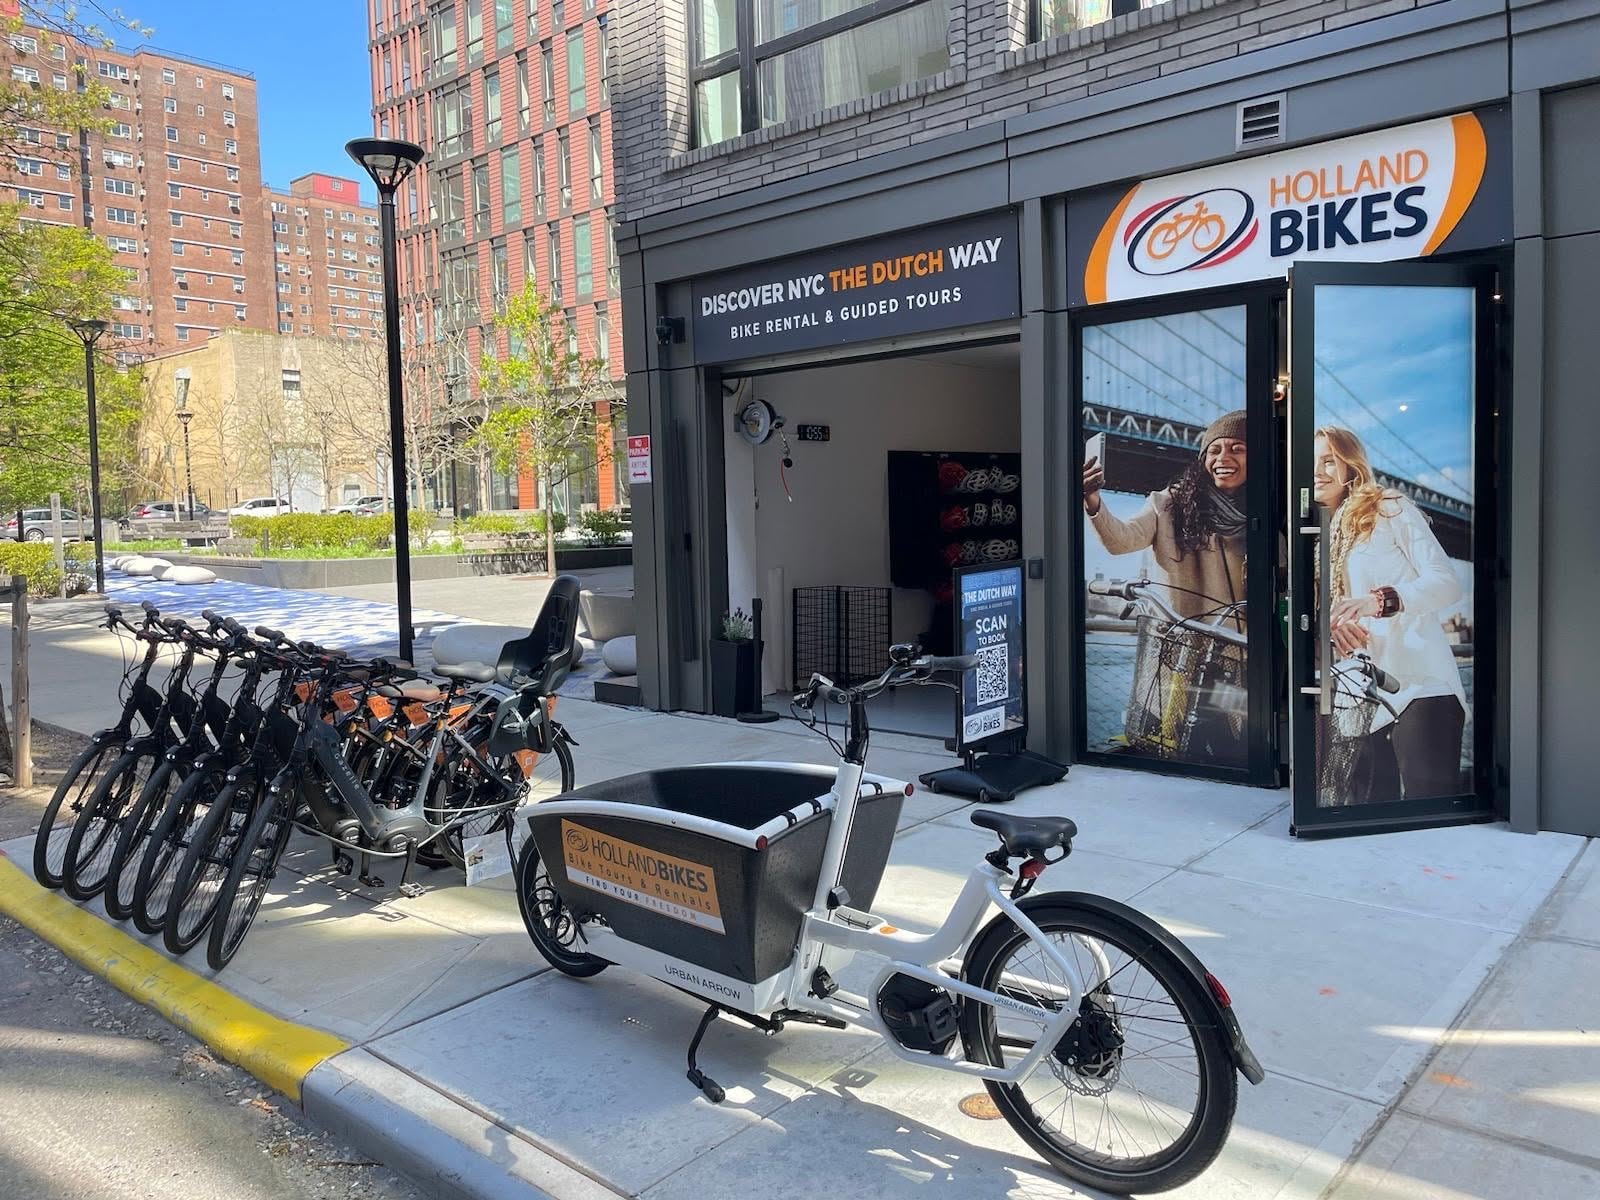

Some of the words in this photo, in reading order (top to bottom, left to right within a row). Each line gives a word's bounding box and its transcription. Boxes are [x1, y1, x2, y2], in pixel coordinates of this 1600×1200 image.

[1270, 149, 1429, 208] HOLLAND
[1270, 186, 1428, 258] BiKES
[701, 282, 784, 317] DISCOVER
[788, 274, 825, 301] NYC
[829, 265, 867, 293] THE
[871, 249, 944, 285] DUTCH
[949, 237, 1002, 270] WAY
[730, 321, 760, 340] BIKE
[766, 312, 819, 333] RENTAL
[825, 310, 833, 324] &
[840, 298, 899, 321] GUIDED
[906, 287, 962, 310] TOURS
[964, 590, 977, 604] THE
[978, 587, 1001, 602] DUTCH
[1001, 584, 1017, 598] WAY
[976, 614, 1007, 635] SCAN
[978, 636, 988, 646] TO
[988, 632, 1006, 644] BOOK
[568, 852, 592, 870] Bike
[599, 863, 633, 885] Tours
[640, 878, 646, 889] &
[655, 884, 711, 911] Rentals
[586, 875, 608, 890] FIND
[613, 882, 639, 900] YOUR
[645, 894, 697, 921] FREEDOM
[664, 963, 700, 985] URBAN
[702, 979, 741, 1000] ARROW
[993, 995, 1019, 1009] URBAN
[1019, 1005, 1046, 1018] ARROW
